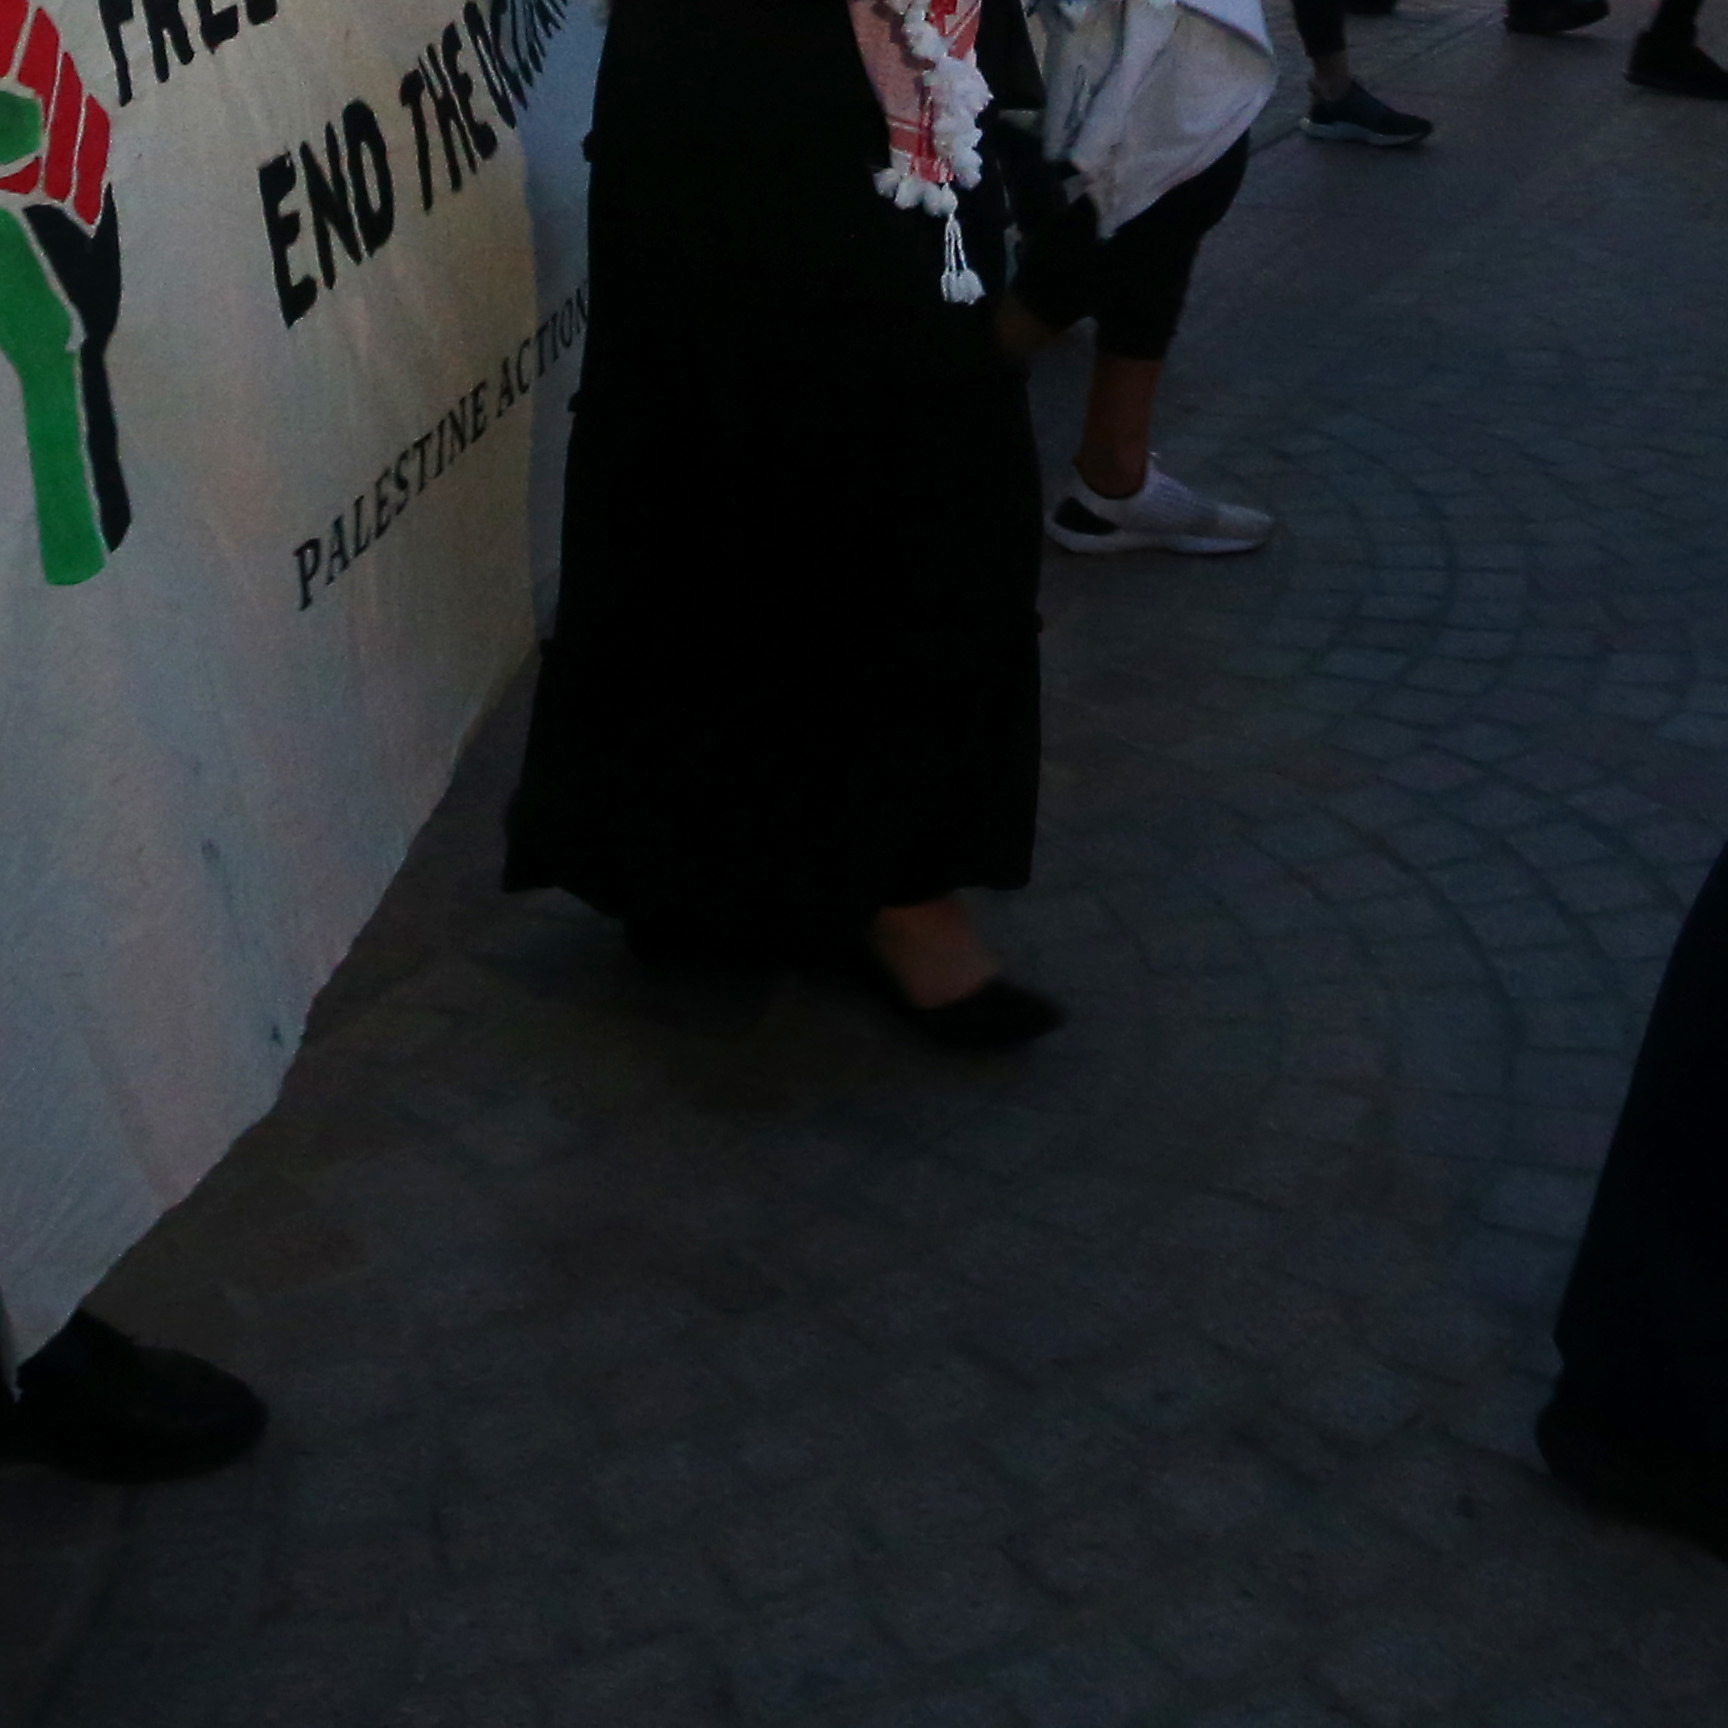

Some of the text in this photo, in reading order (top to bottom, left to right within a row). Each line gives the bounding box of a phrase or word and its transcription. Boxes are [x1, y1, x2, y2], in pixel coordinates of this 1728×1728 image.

[259, 98, 394, 328] END
[400, 20, 498, 214] THE
[291, 287, 589, 611] PALESTINE ACTION
